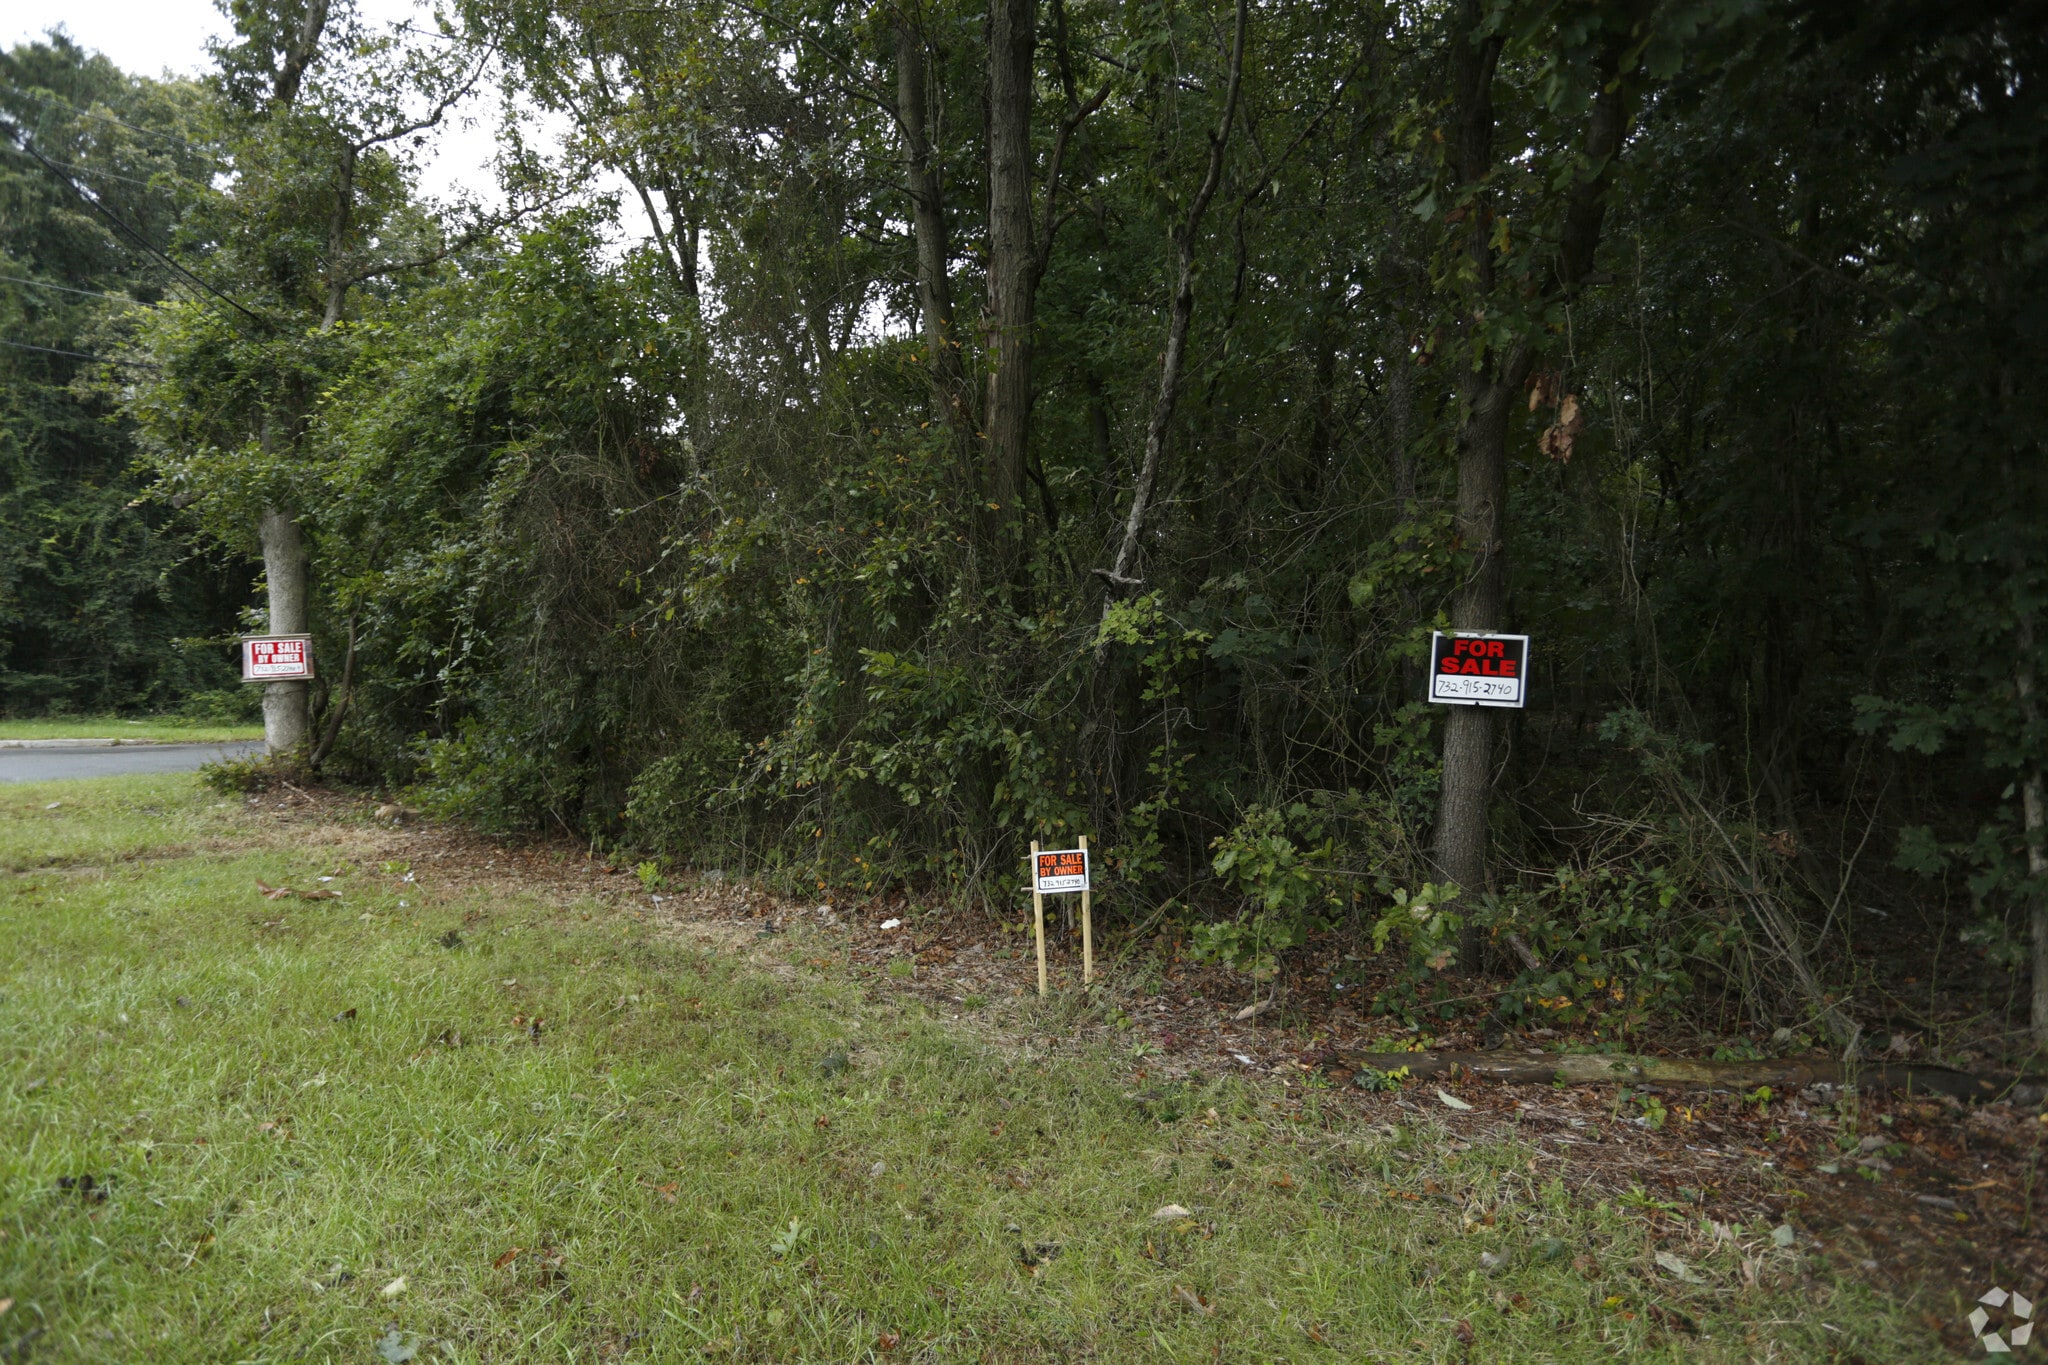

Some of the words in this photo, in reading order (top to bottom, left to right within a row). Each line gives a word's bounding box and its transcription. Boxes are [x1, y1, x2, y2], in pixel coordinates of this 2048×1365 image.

[254, 643, 274, 655] FOR
[277, 642, 301, 653] SALE
[1453, 639, 1505, 658] FOR
[258, 654, 269, 664] BY
[271, 653, 300, 663] OWNER
[1440, 656, 1518, 677] SALE
[1039, 855, 1057, 867] FOR
[1060, 853, 1083, 865] SALE
[1040, 867, 1051, 877] BY
[1054, 865, 1083, 876] OWNER
